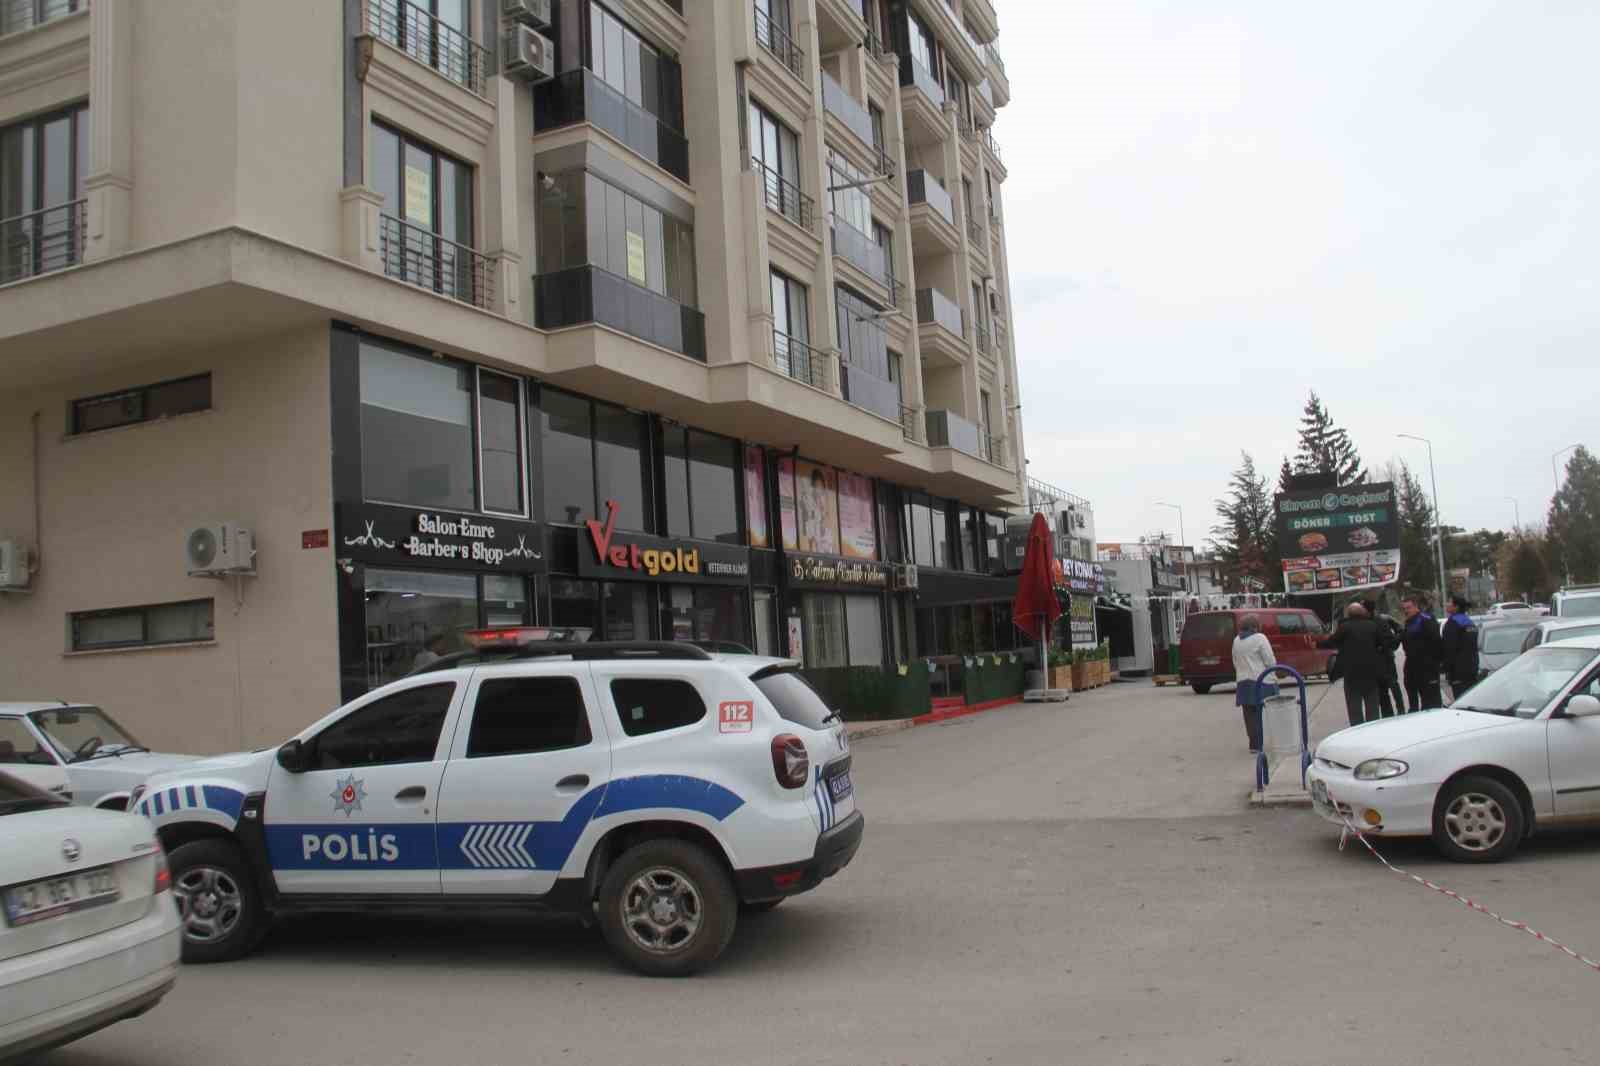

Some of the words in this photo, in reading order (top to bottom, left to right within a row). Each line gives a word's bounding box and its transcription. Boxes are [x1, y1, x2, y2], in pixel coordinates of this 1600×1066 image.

[418, 513, 457, 535] Salon
[457, 518, 495, 539] Emre
[1348, 512, 1376, 524] TOST
[404, 536, 469, 559] Barber's
[472, 541, 504, 565] Shop
[586, 499, 699, 577] Vetgold
[723, 704, 748, 721] 112
[302, 828, 400, 861] POLİS
